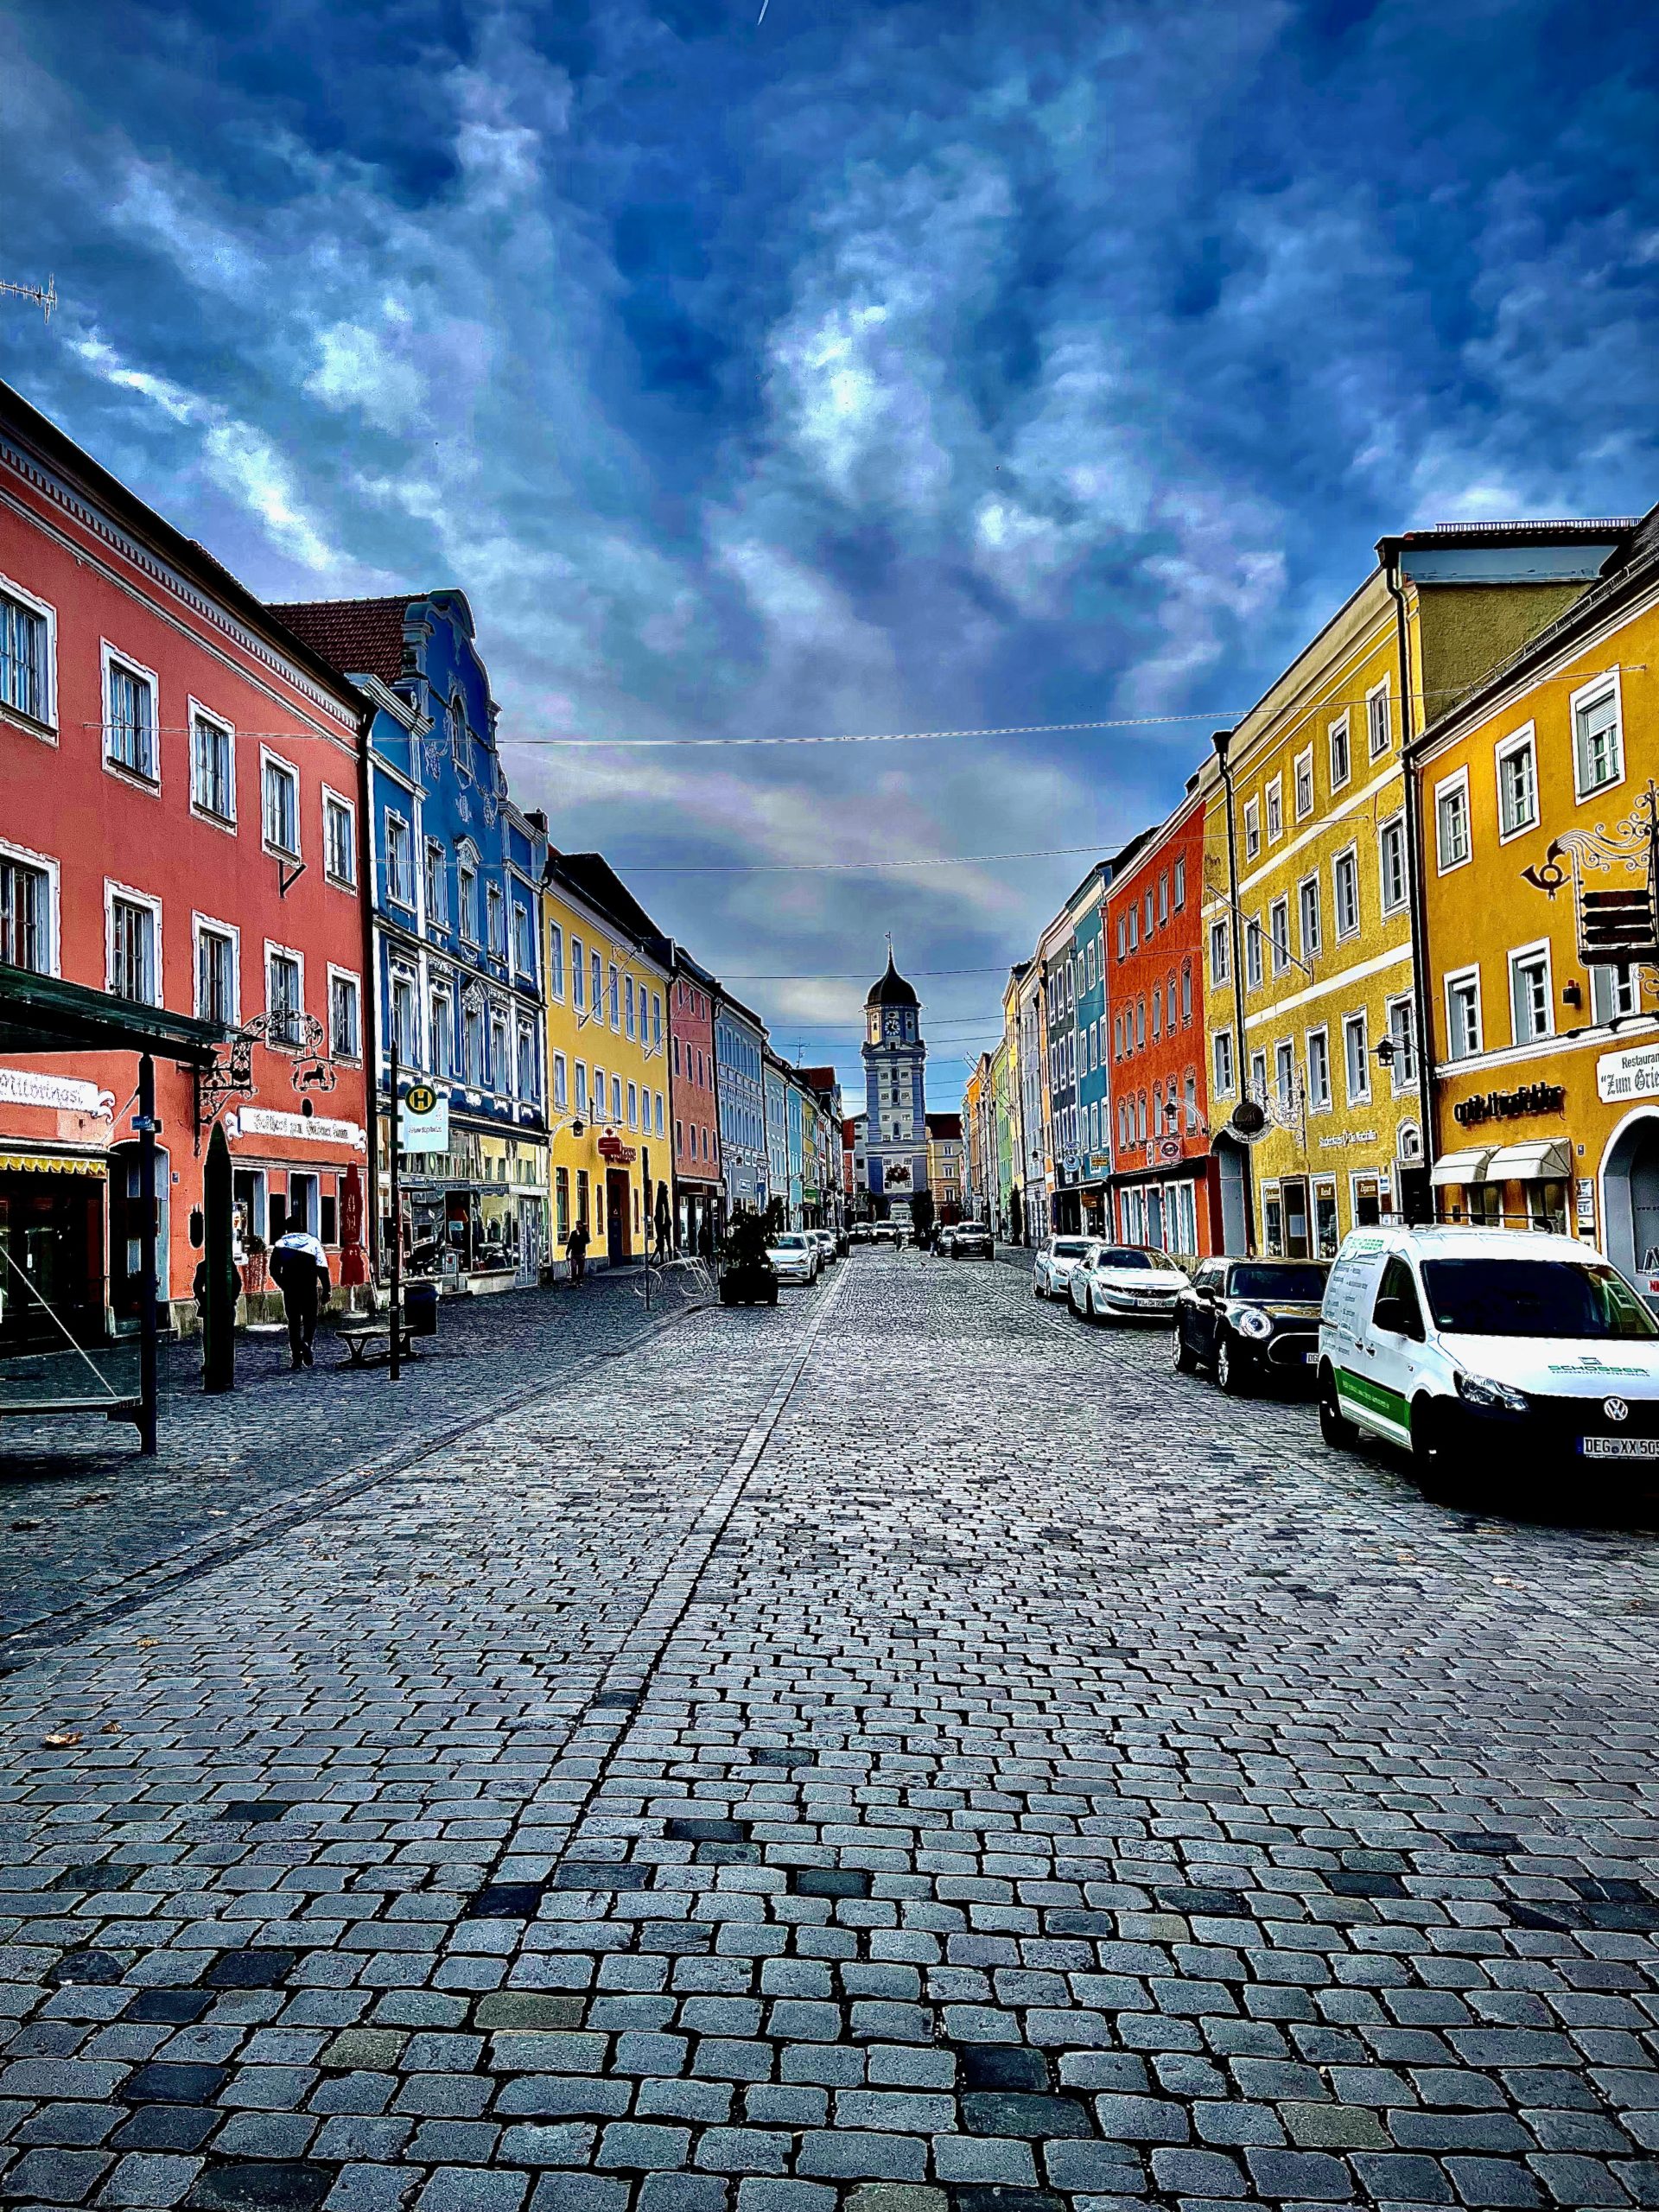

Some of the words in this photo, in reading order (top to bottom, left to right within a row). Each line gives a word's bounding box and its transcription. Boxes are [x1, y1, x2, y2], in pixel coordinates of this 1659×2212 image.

[413, 1090, 429, 1108] H
[1548, 1365, 1649, 1374] SCHOSSER
[1585, 1438, 1611, 1453] DEG
[1620, 1440, 1637, 1454] XX
